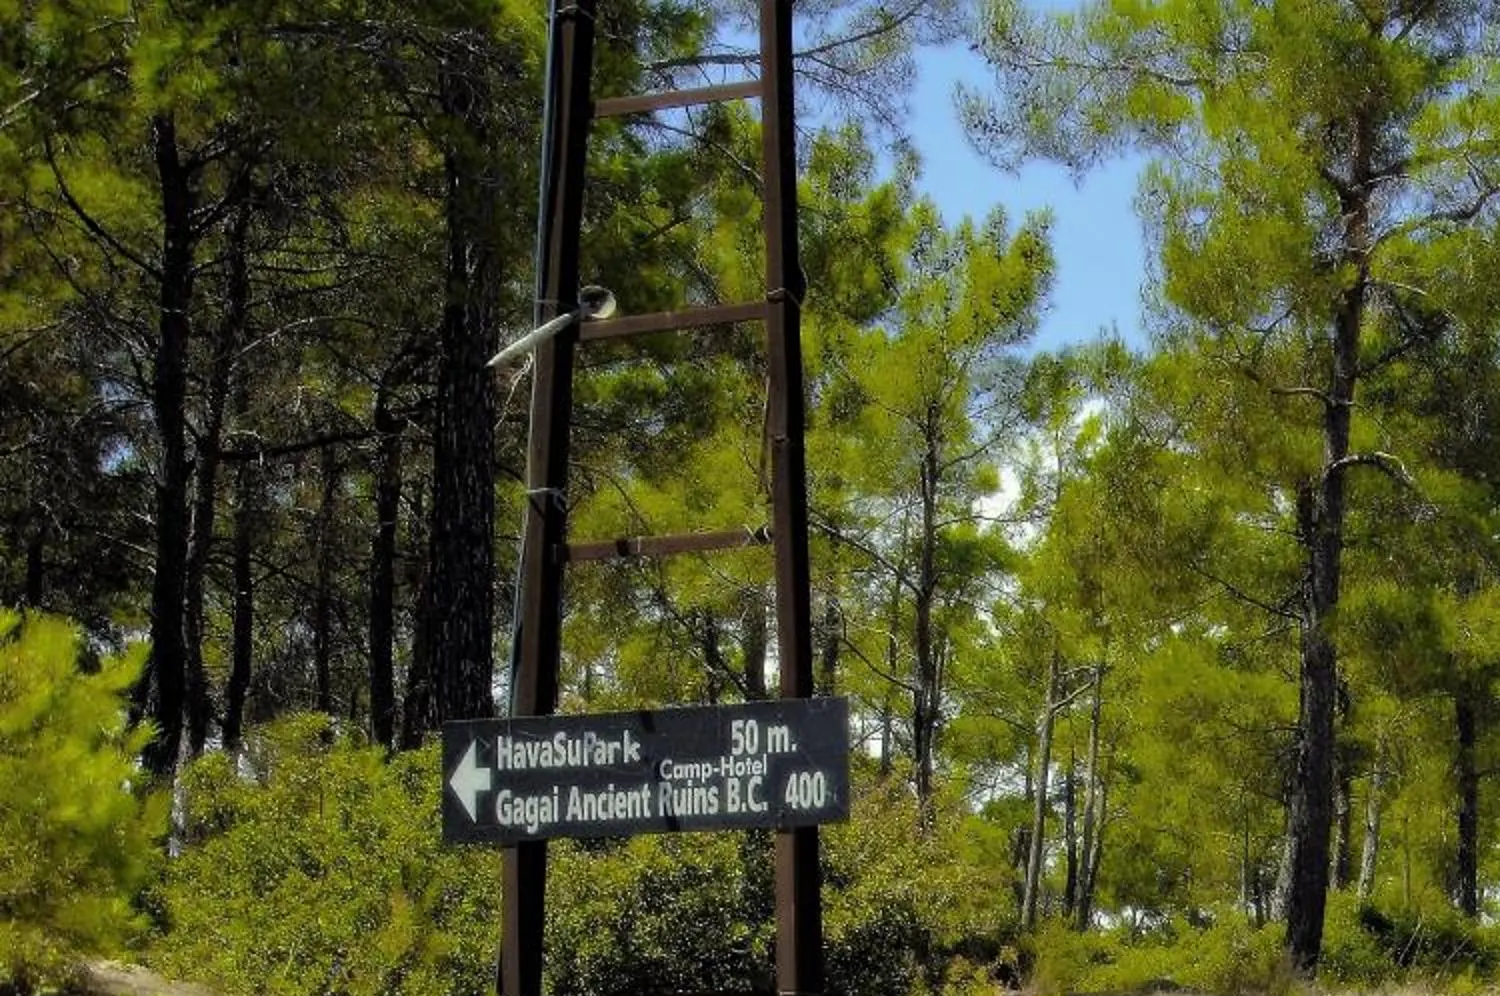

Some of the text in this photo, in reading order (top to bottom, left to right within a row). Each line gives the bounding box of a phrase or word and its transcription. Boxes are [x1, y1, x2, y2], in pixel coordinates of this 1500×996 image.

[497, 720, 798, 770] HavaSuPark 50 m.
[659, 754, 767, 782] Camp-Hotel
[496, 770, 826, 835] Gagai Ancient Ruins B.C. 400
